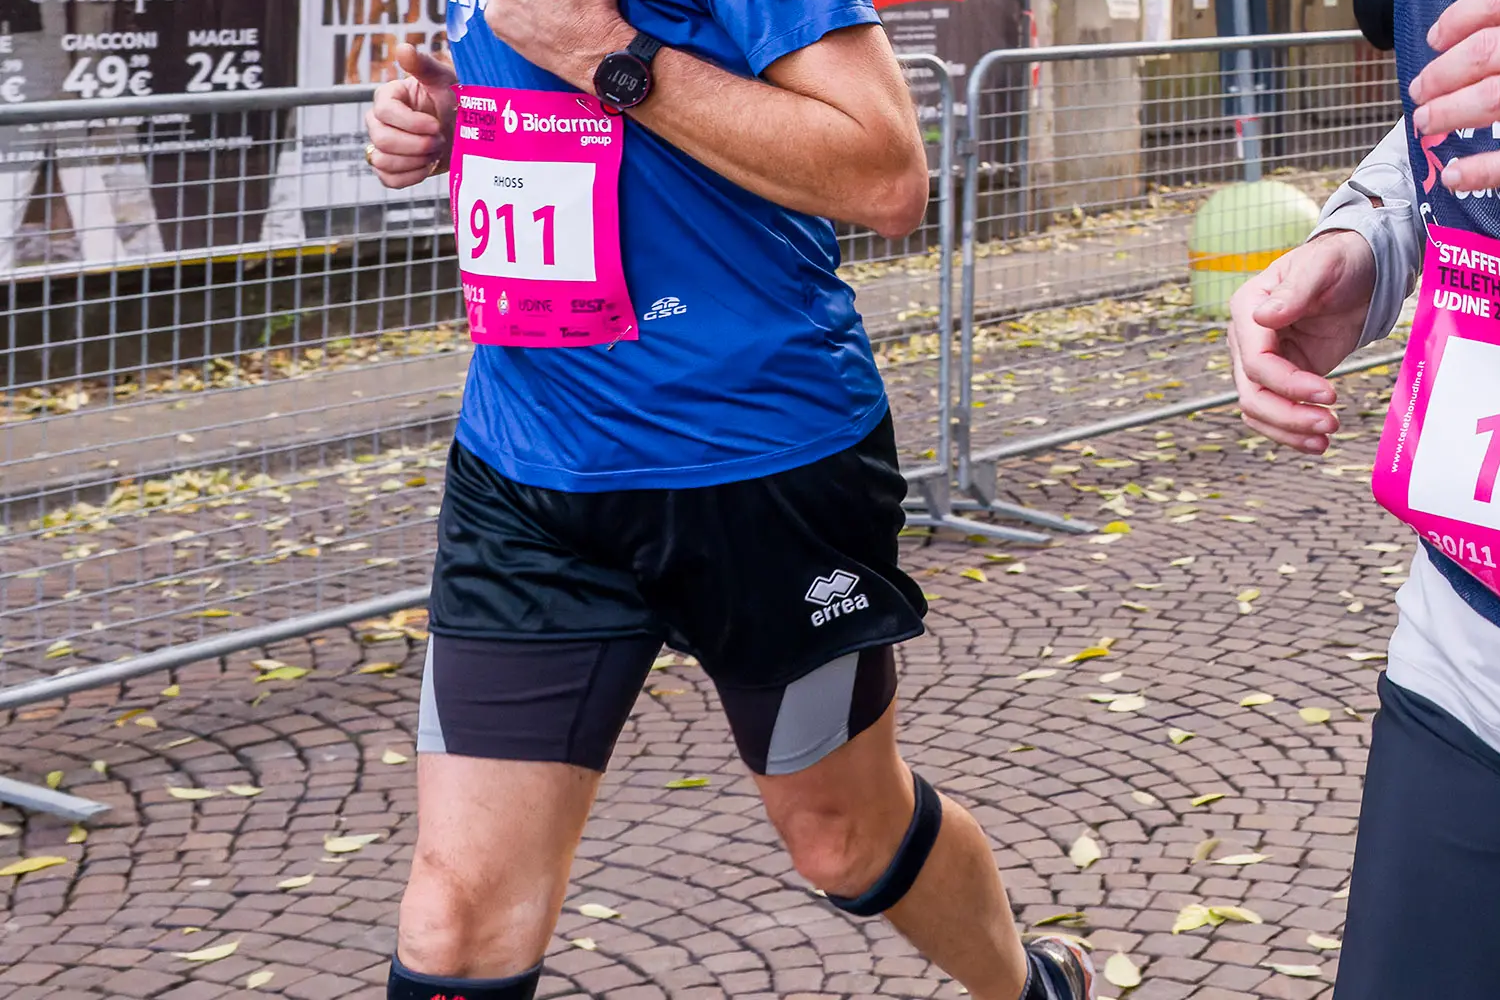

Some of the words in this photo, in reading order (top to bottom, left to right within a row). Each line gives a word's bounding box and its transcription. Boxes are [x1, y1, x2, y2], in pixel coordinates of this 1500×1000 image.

[61, 32, 158, 51] GIACCONI
[188, 28, 259, 47] MAGLIE
[522, 113, 612, 133] Biofarma
[580, 135, 612, 147] group
[493, 175, 524, 189] RHOSS
[470, 199, 555, 266] 911
[518, 299, 553, 313] UDINE
[1433, 288, 1491, 318] UDINE
[1391, 360, 1426, 473] www.telethonudine.it
